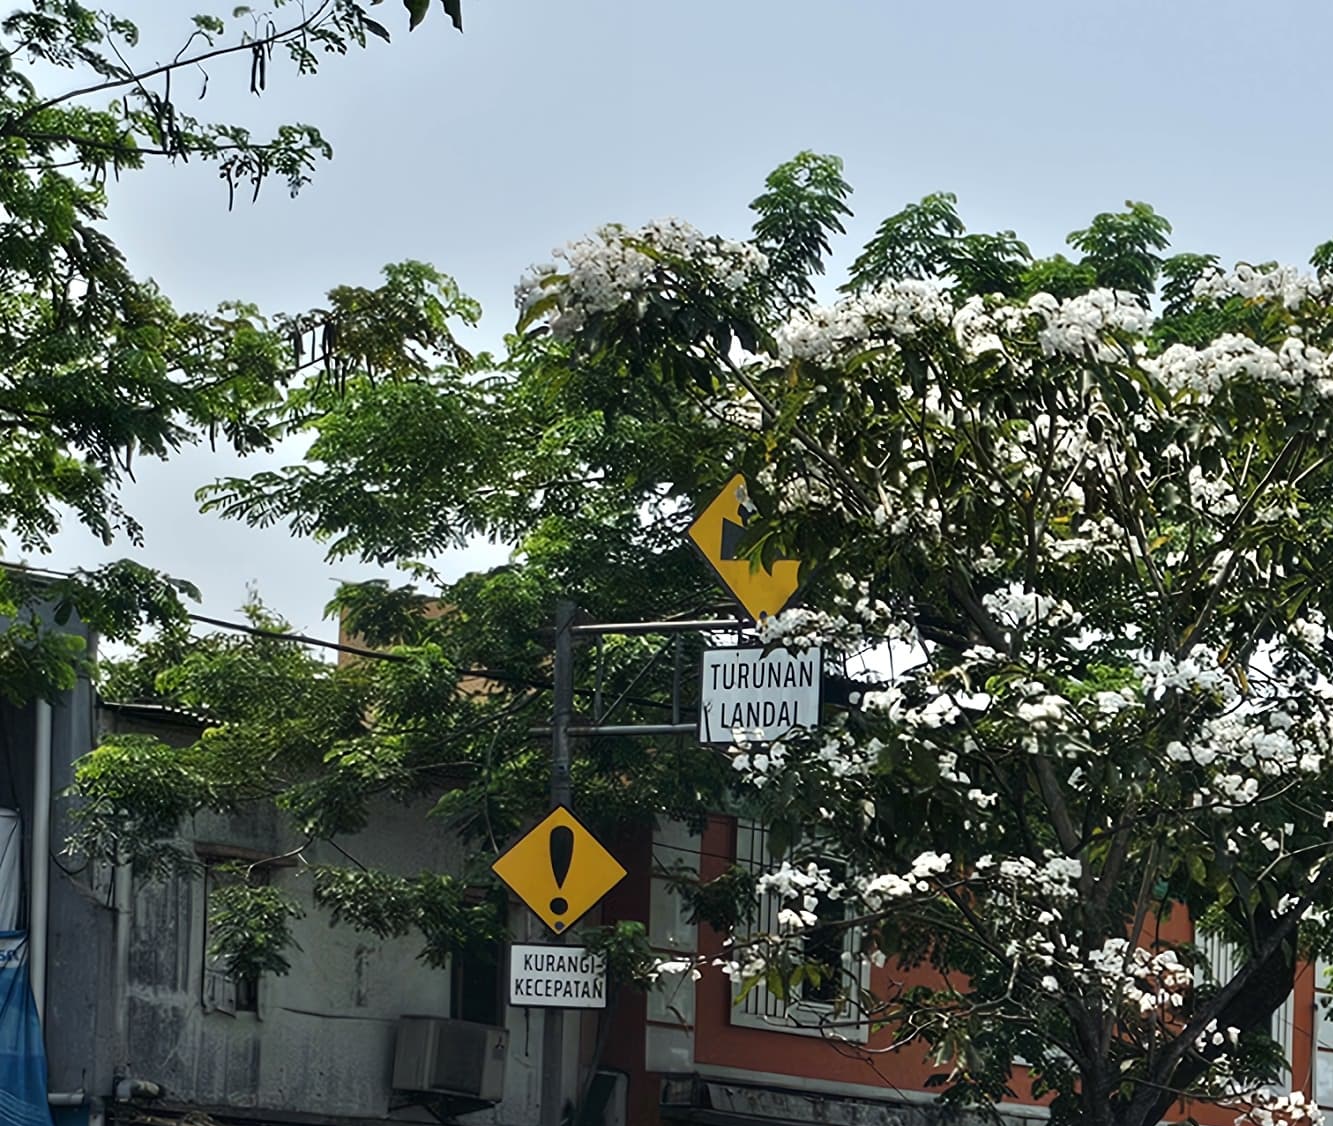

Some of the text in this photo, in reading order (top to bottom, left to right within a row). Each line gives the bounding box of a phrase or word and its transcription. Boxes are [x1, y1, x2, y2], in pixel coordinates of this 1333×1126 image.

[711, 661, 812, 690] TURUNAN
[721, 701, 798, 728] LANDAI
[524, 953, 595, 974] KURANGI
[515, 978, 603, 998] KECEPATAN
